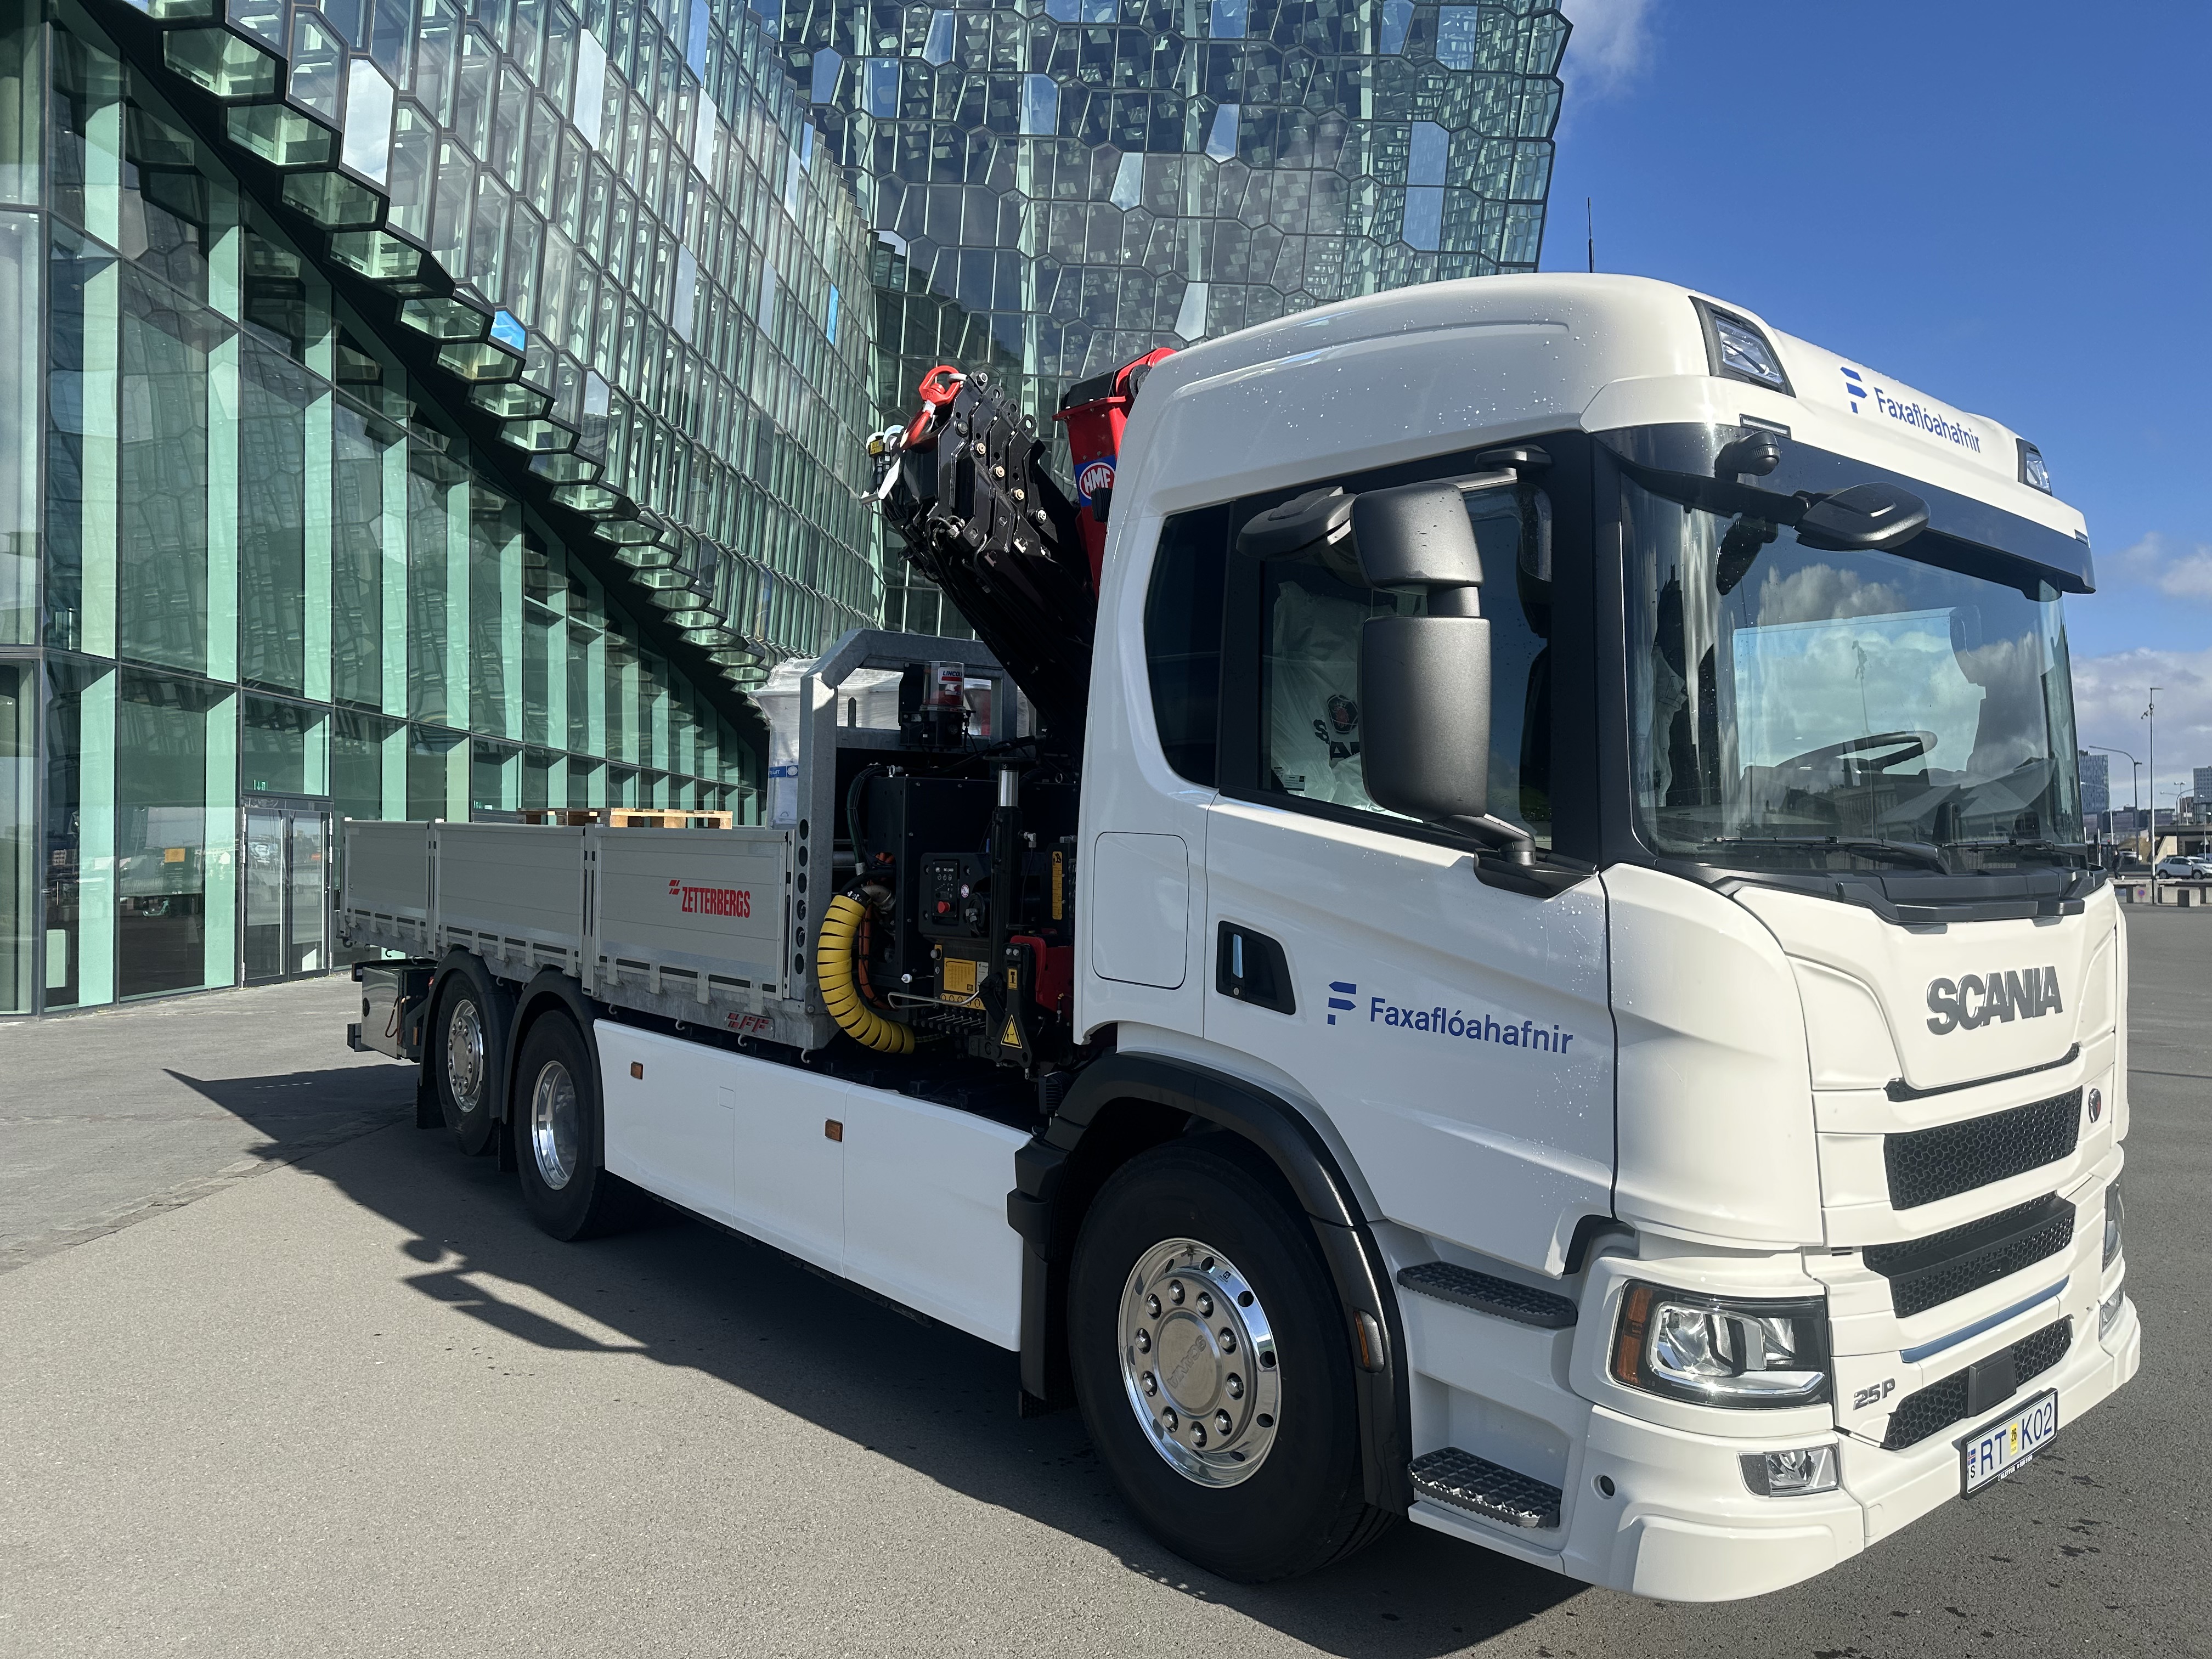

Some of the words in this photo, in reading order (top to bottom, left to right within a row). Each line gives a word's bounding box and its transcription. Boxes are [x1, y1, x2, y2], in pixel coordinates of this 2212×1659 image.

[1874, 386, 1981, 453] Faxaflóahafnir
[1084, 467, 1111, 494] HMF
[681, 886, 751, 918] ZETTERBERGS
[1370, 996, 1573, 1054] Faxaflóahafnir
[1926, 966, 2063, 1036] SCANIA
[1166, 1335, 1207, 1389] SCANIA
[1853, 1378, 1895, 1410] 25P
[1981, 1429, 2006, 1476] RT
[2022, 1402, 2052, 1450] K02
